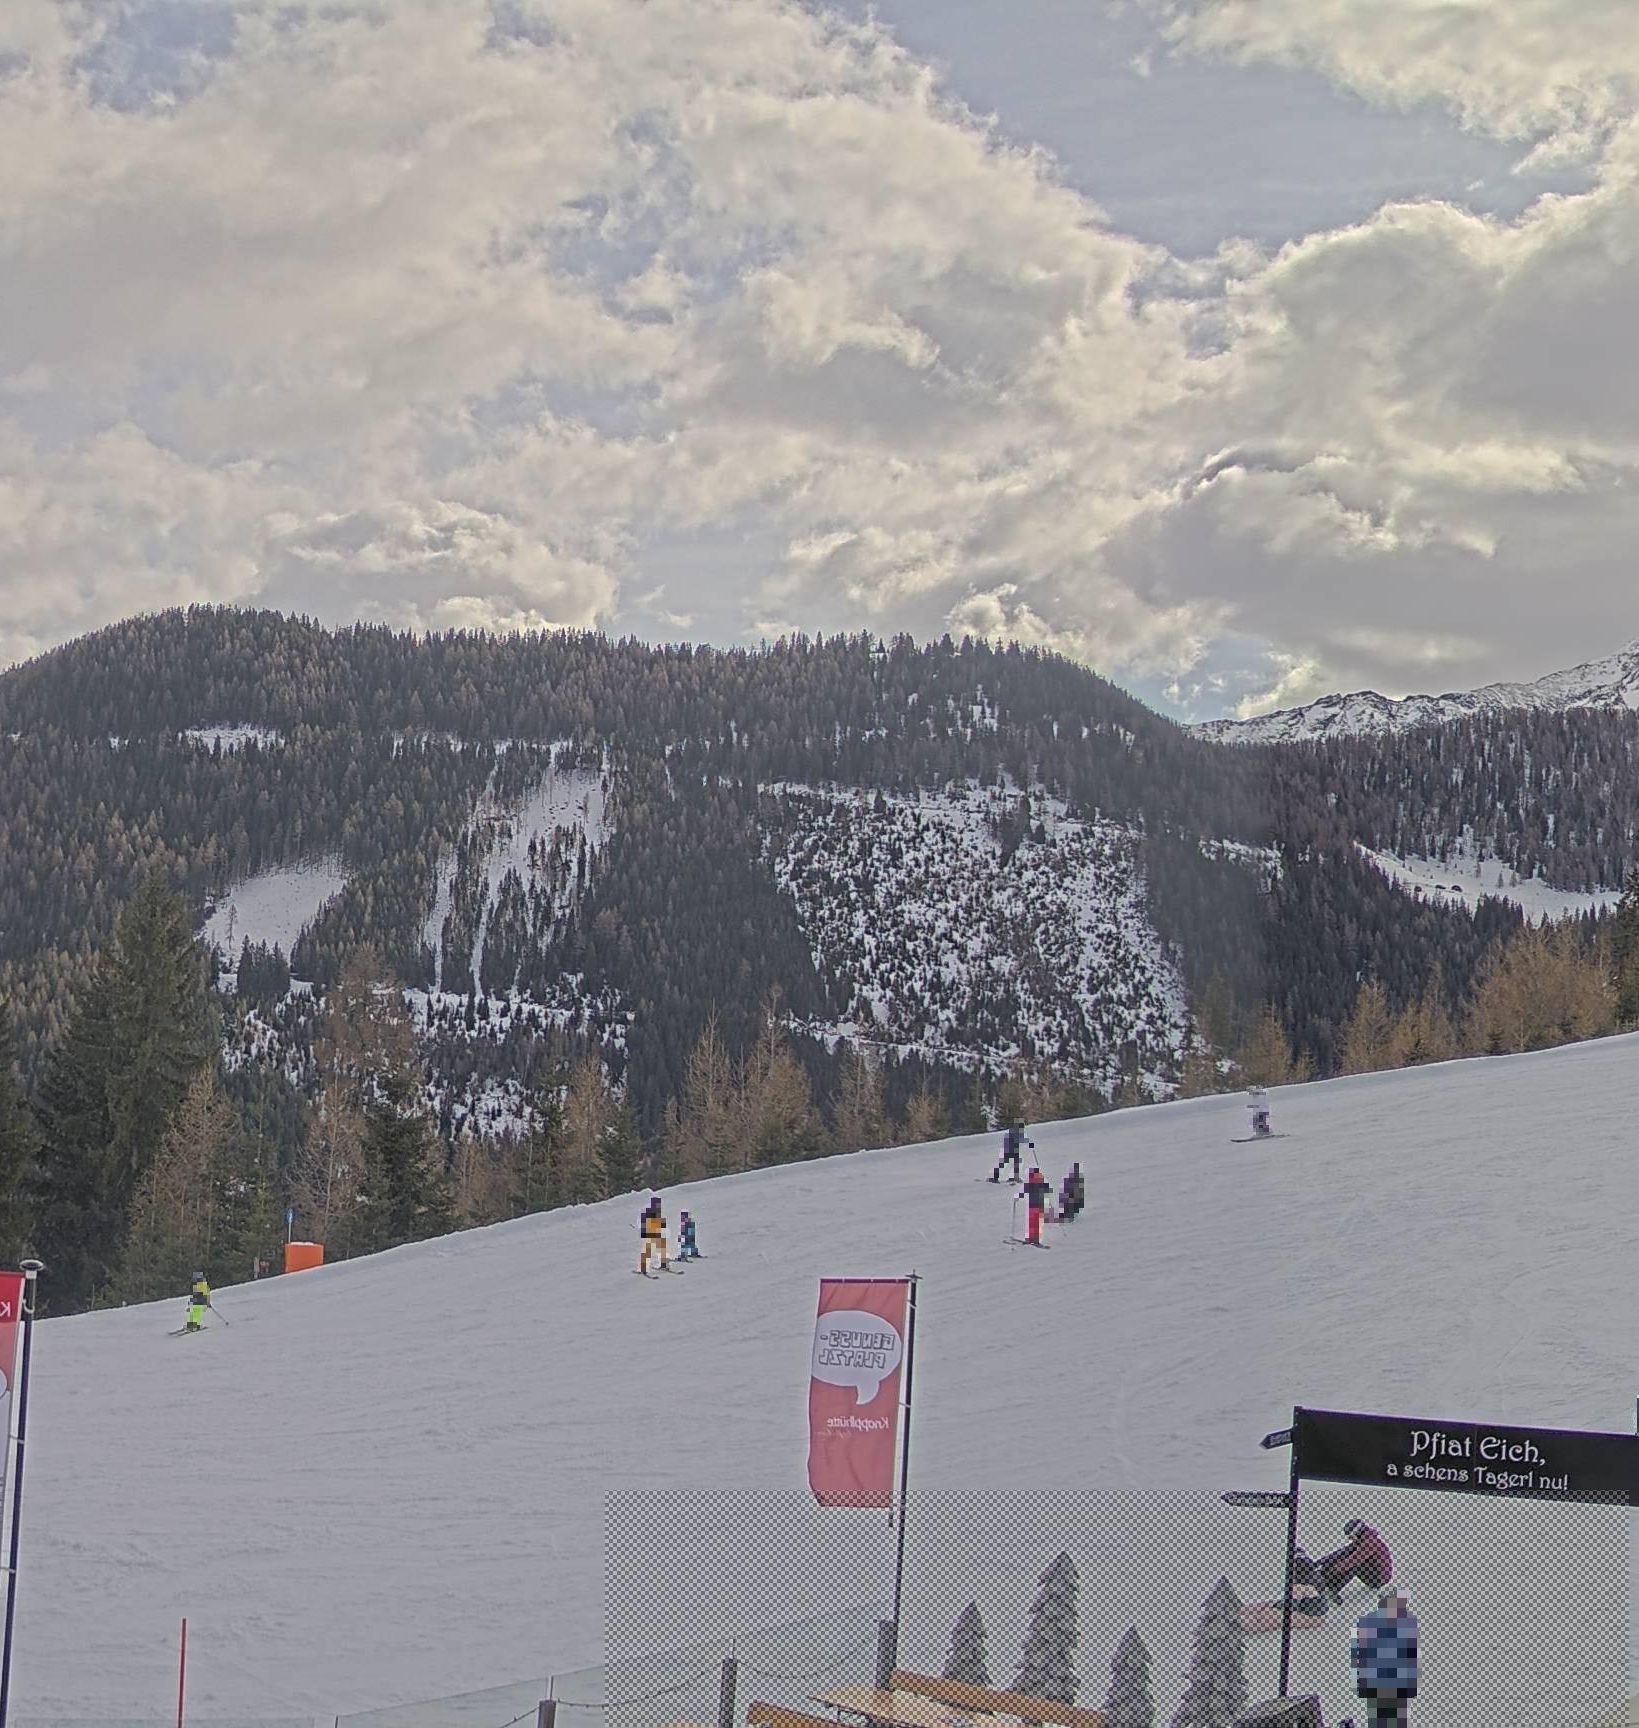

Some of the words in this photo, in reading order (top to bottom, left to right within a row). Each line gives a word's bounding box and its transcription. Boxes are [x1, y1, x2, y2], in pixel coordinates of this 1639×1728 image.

[1410, 1430, 1472, 1460] Pfiat
[1479, 1436, 1546, 1466] Eich,
[1387, 1463, 1398, 1476] a
[1403, 1463, 1470, 1482] schens
[1474, 1466, 1533, 1490] Tagerl
[1539, 1474, 1569, 1491] nu!
